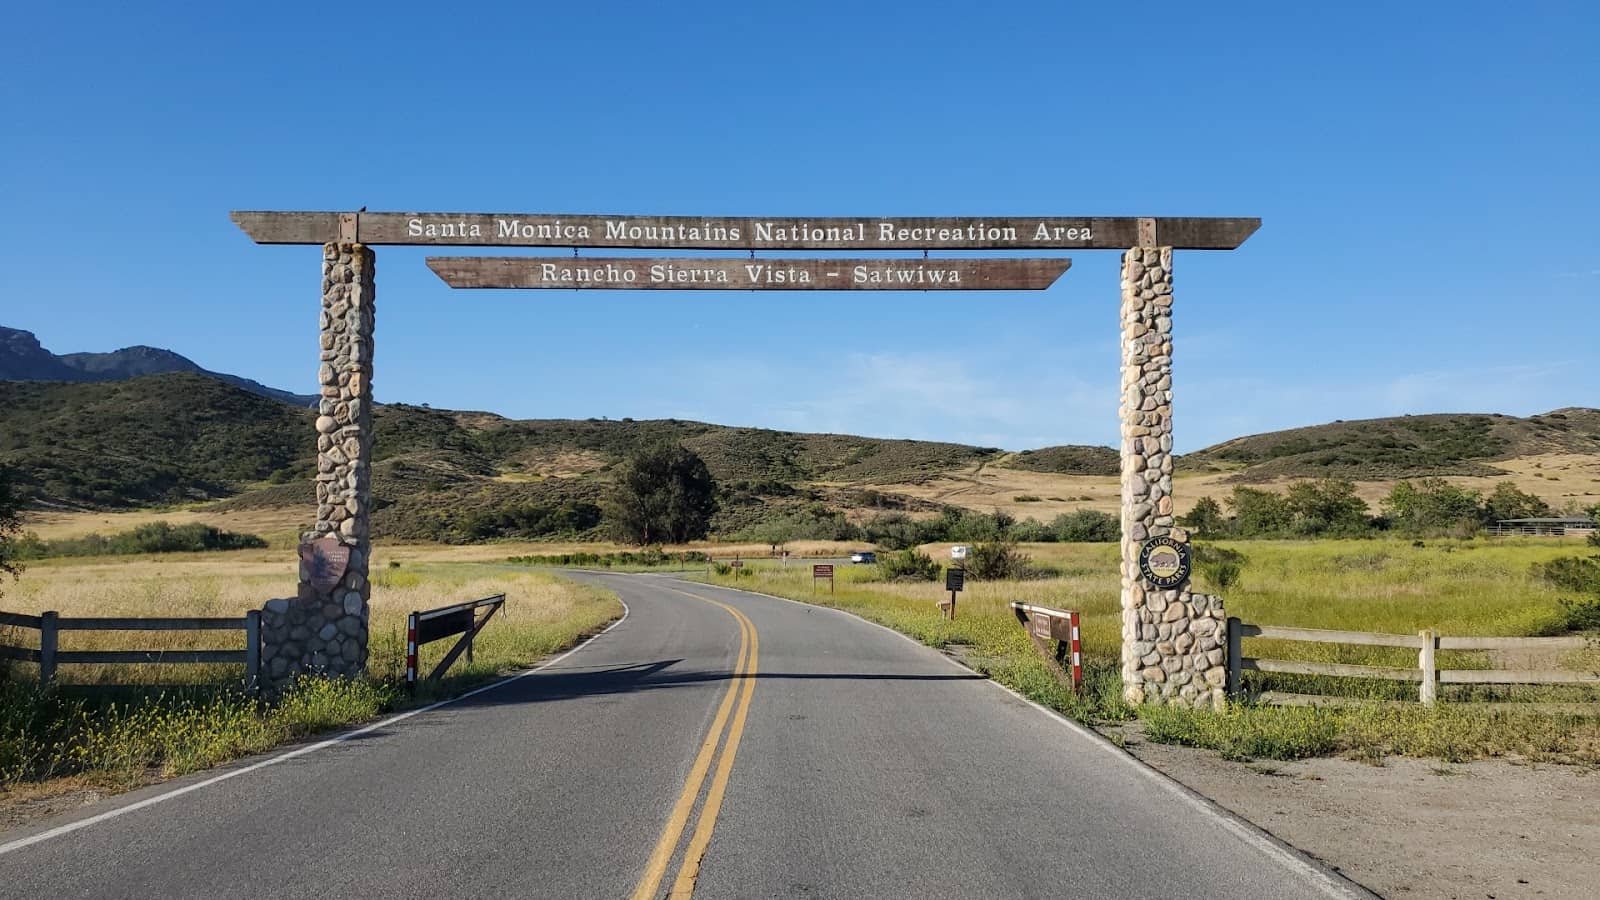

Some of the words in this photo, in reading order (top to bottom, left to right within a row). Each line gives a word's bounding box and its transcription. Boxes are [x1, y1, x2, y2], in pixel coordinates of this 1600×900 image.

[408, 219, 482, 238] Santa
[498, 219, 591, 239] Monica
[605, 221, 741, 241] Mountains
[754, 223, 865, 241] National
[879, 223, 1018, 242] Recreation
[1033, 223, 1094, 242] Area
[541, 263, 637, 282] Rancho
[650, 264, 729, 283] Sierra
[745, 265, 811, 283] Vista
[853, 265, 962, 283] Satwiwa
